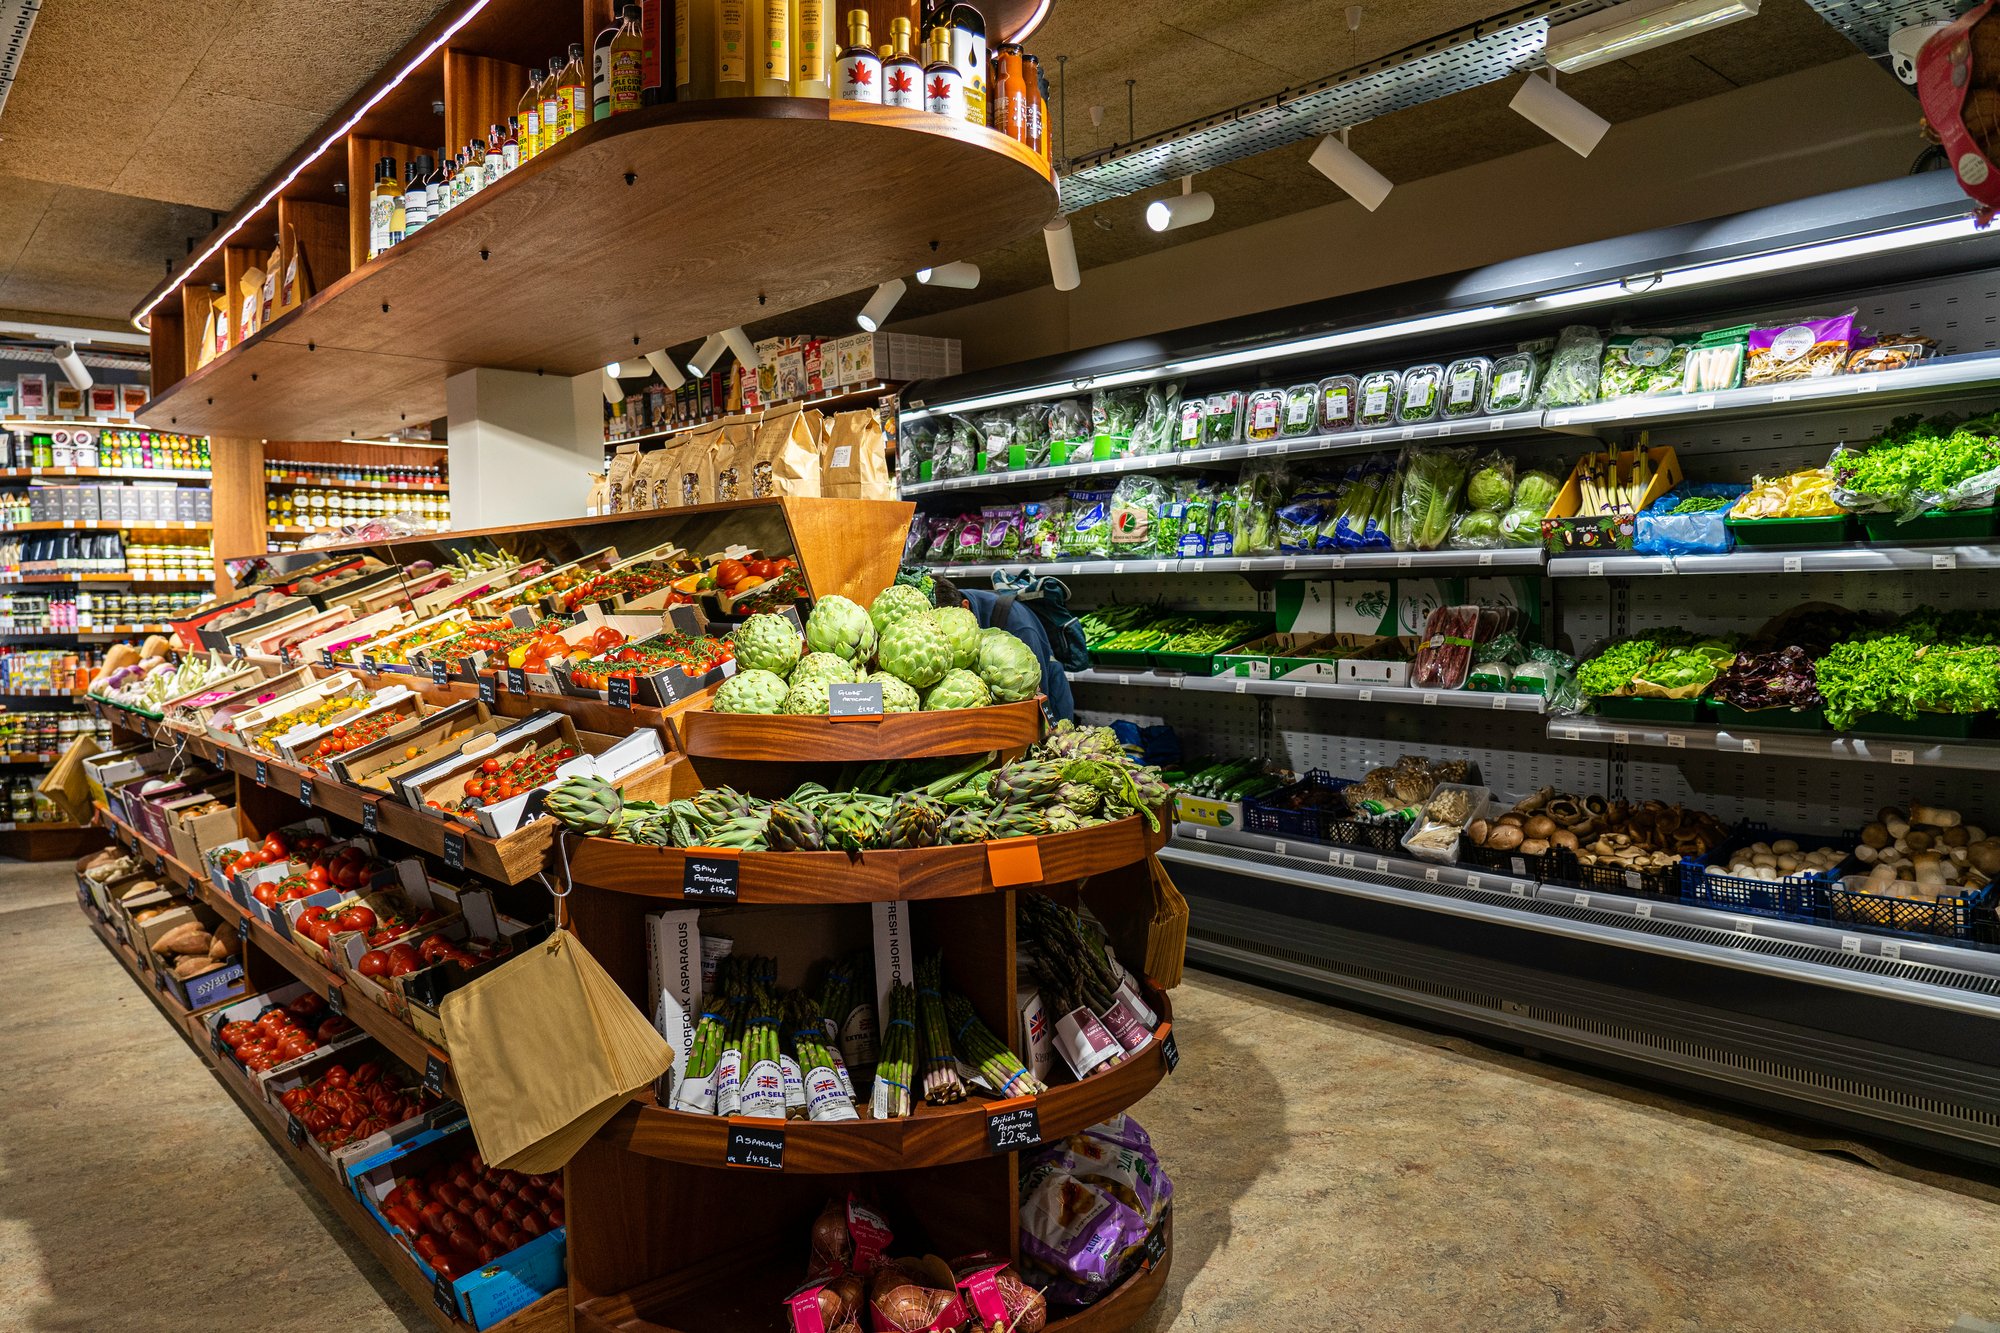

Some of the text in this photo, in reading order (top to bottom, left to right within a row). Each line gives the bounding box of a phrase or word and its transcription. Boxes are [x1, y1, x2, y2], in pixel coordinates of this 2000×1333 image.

[842, 89, 859, 98] pure
[662, 675, 676, 697] BLISS
[196, 971, 232, 996] SWEET
[678, 922, 692, 1057] NORFOLK ASPARAGUS
[741, 1090, 766, 1103] EXTRA
[991, 1110, 1034, 1127] British Thin
[997, 1121, 1032, 1132] Asparagus
[996, 1130, 1028, 1146] £2.95
[746, 1150, 770, 1164] £4.95
